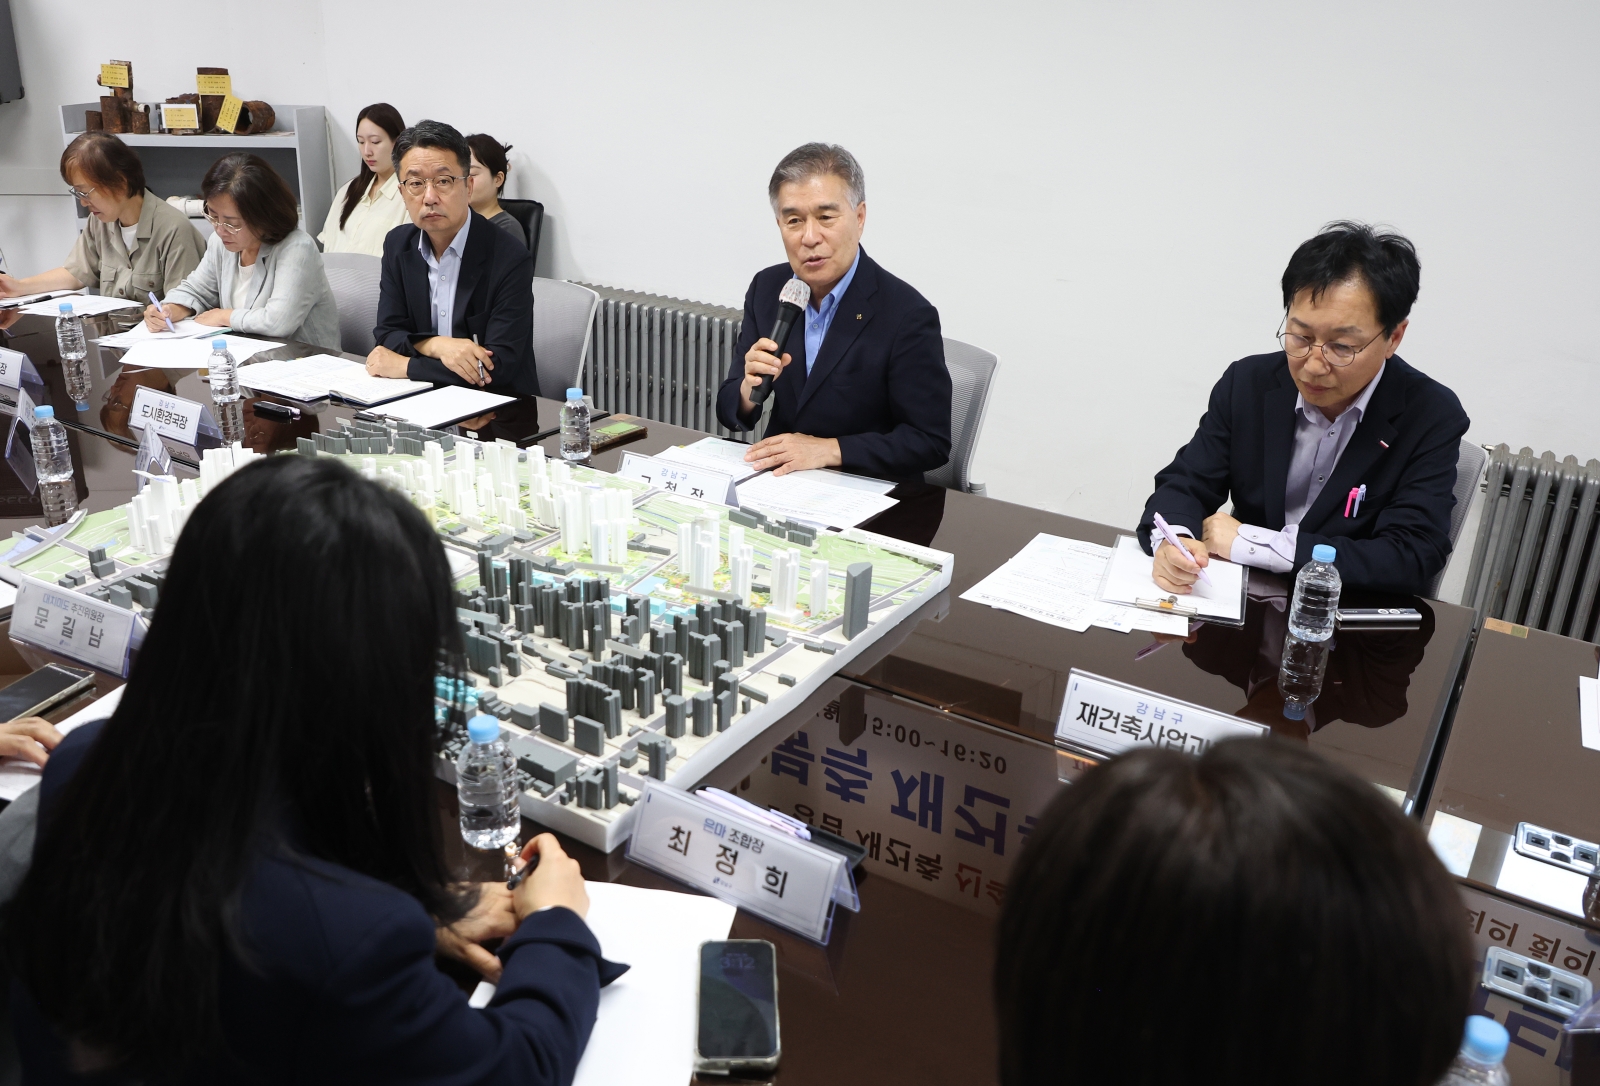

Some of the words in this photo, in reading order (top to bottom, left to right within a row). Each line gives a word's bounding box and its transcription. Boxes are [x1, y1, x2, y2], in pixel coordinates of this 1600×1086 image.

[141, 404, 188, 430] 도시환경국장
[661, 468, 688, 481] 강남구
[42, 593, 70, 611] 대치미도
[70, 602, 105, 623] 추진위원장
[1136, 701, 1183, 725] 강남구
[702, 817, 727, 839] 은마
[727, 828, 765, 854] 조합장
